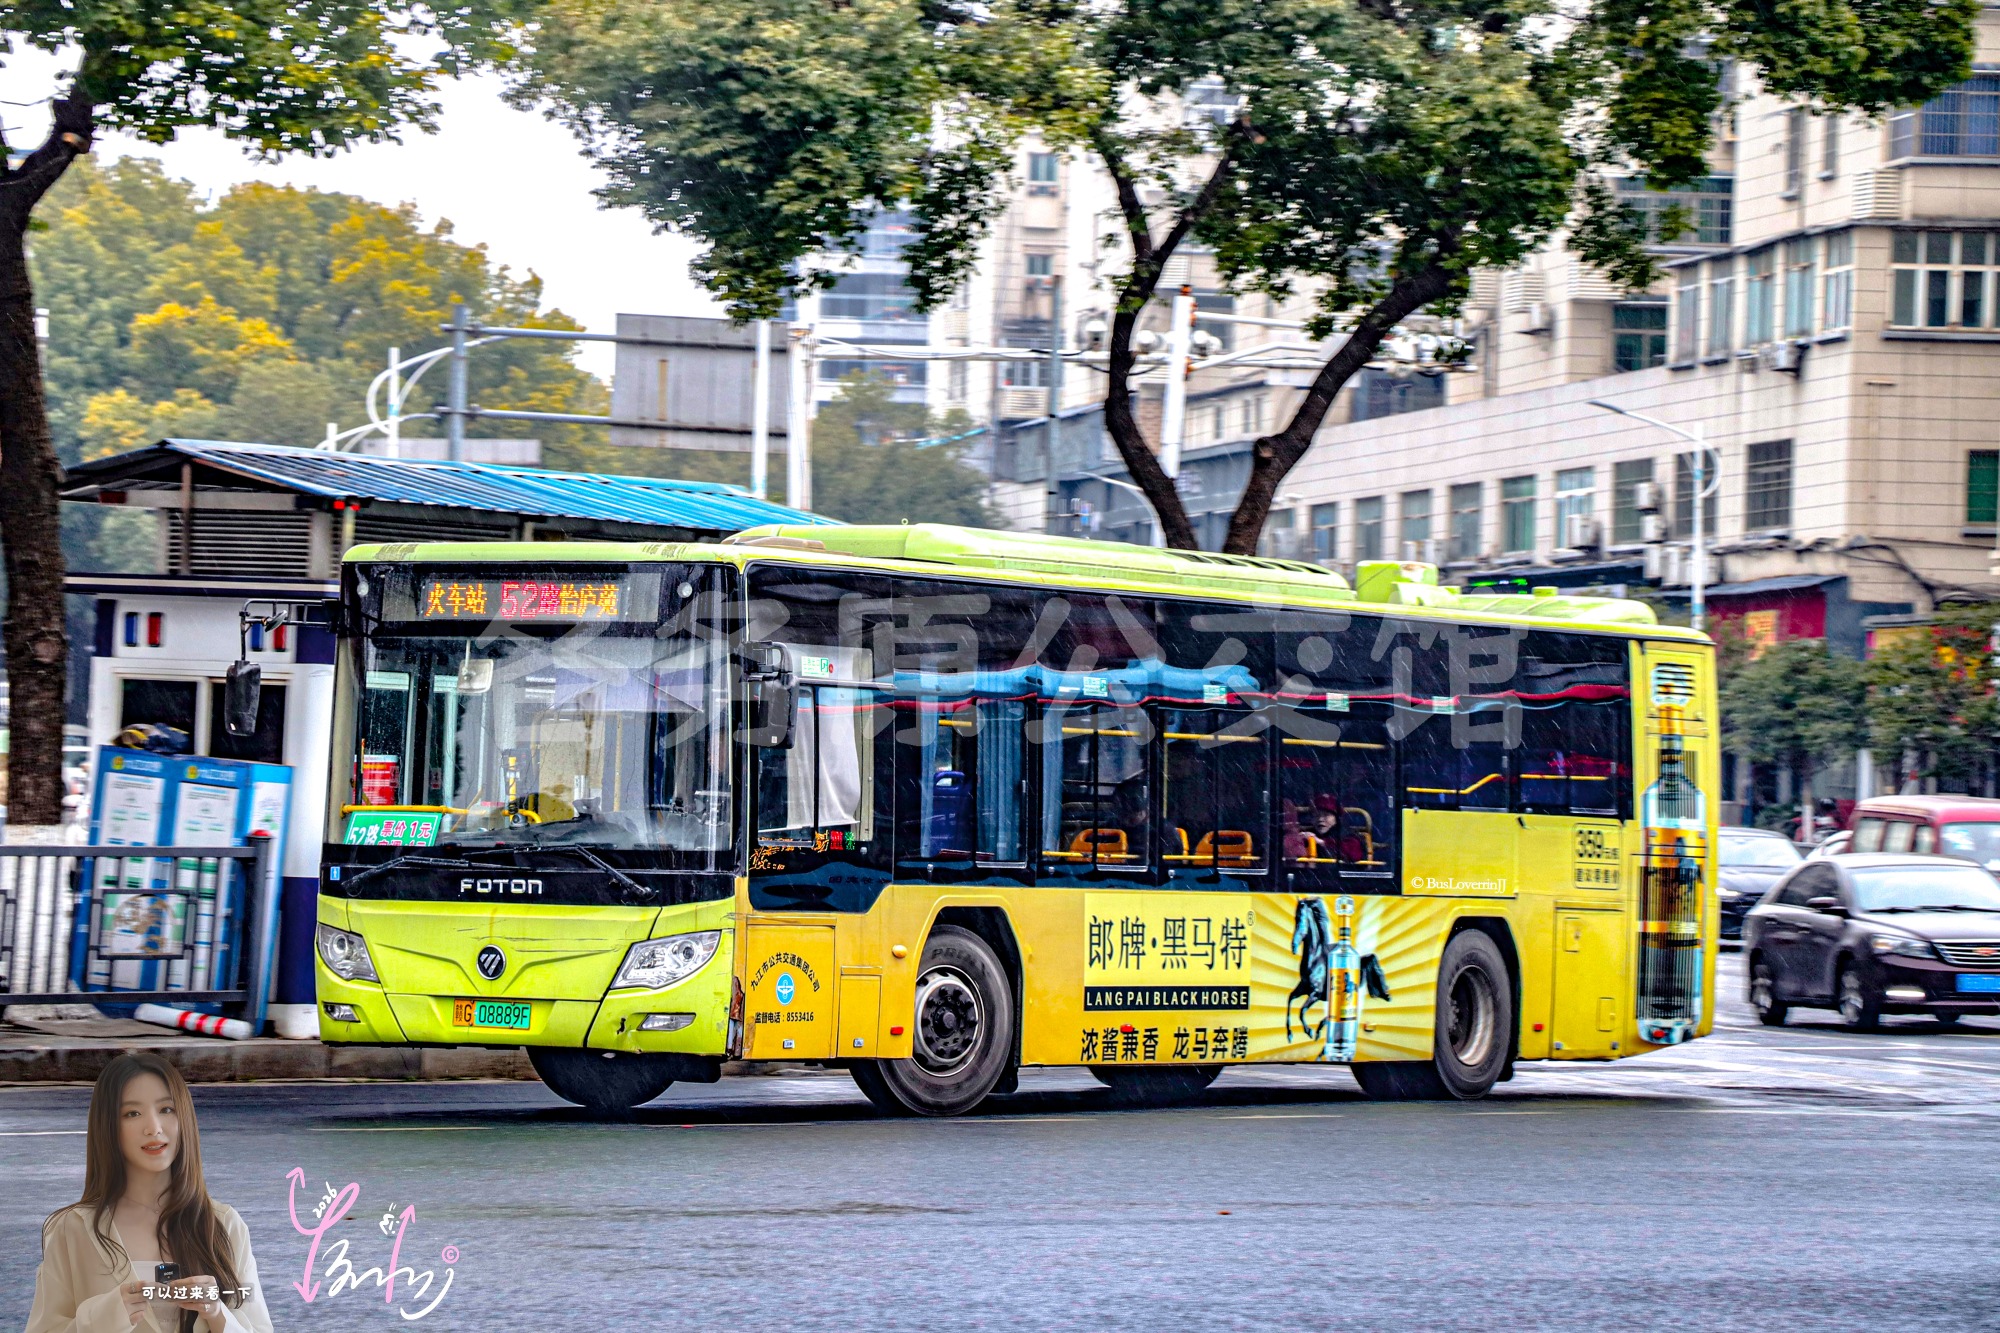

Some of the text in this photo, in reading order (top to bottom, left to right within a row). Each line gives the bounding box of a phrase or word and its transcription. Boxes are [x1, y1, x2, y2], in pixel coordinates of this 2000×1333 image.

[425, 583, 487, 616] 火车站
[501, 581, 560, 618] 52路
[460, 878, 543, 895] FOTON
[750, 952, 820, 992] 九江市公共交通集团公司
[1086, 991, 1248, 1007] LANG PAI BLACK HORSE
[1080, 1026, 1248, 1062] 浓酱兼香 龙马奔腾
